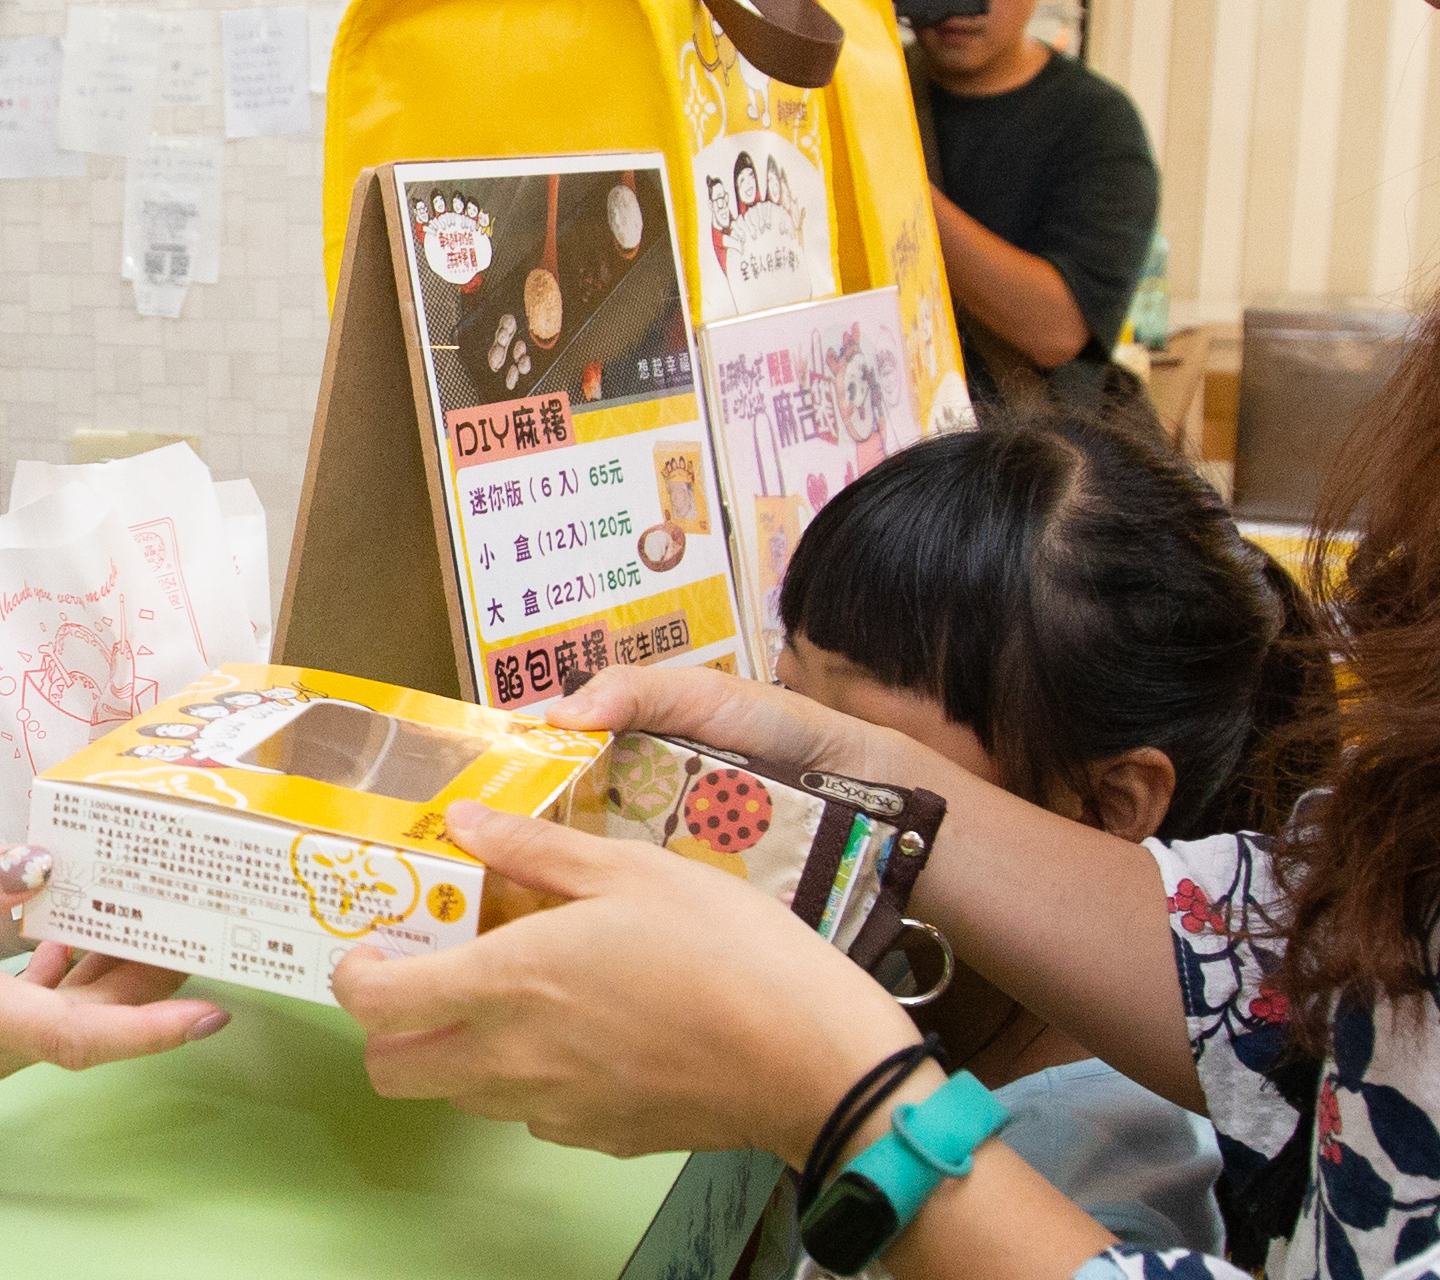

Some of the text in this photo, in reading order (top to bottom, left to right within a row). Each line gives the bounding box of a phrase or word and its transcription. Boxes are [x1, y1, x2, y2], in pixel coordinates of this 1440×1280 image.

[636, 351, 691, 380] 想起幸福
[456, 398, 568, 458] DIY麻糬
[588, 458, 625, 487] 65元
[588, 509, 633, 541] 120元
[33, 586, 53, 604] you
[56, 593, 87, 610] very
[85, 556, 119, 604] much
[597, 560, 642, 591] 180元
